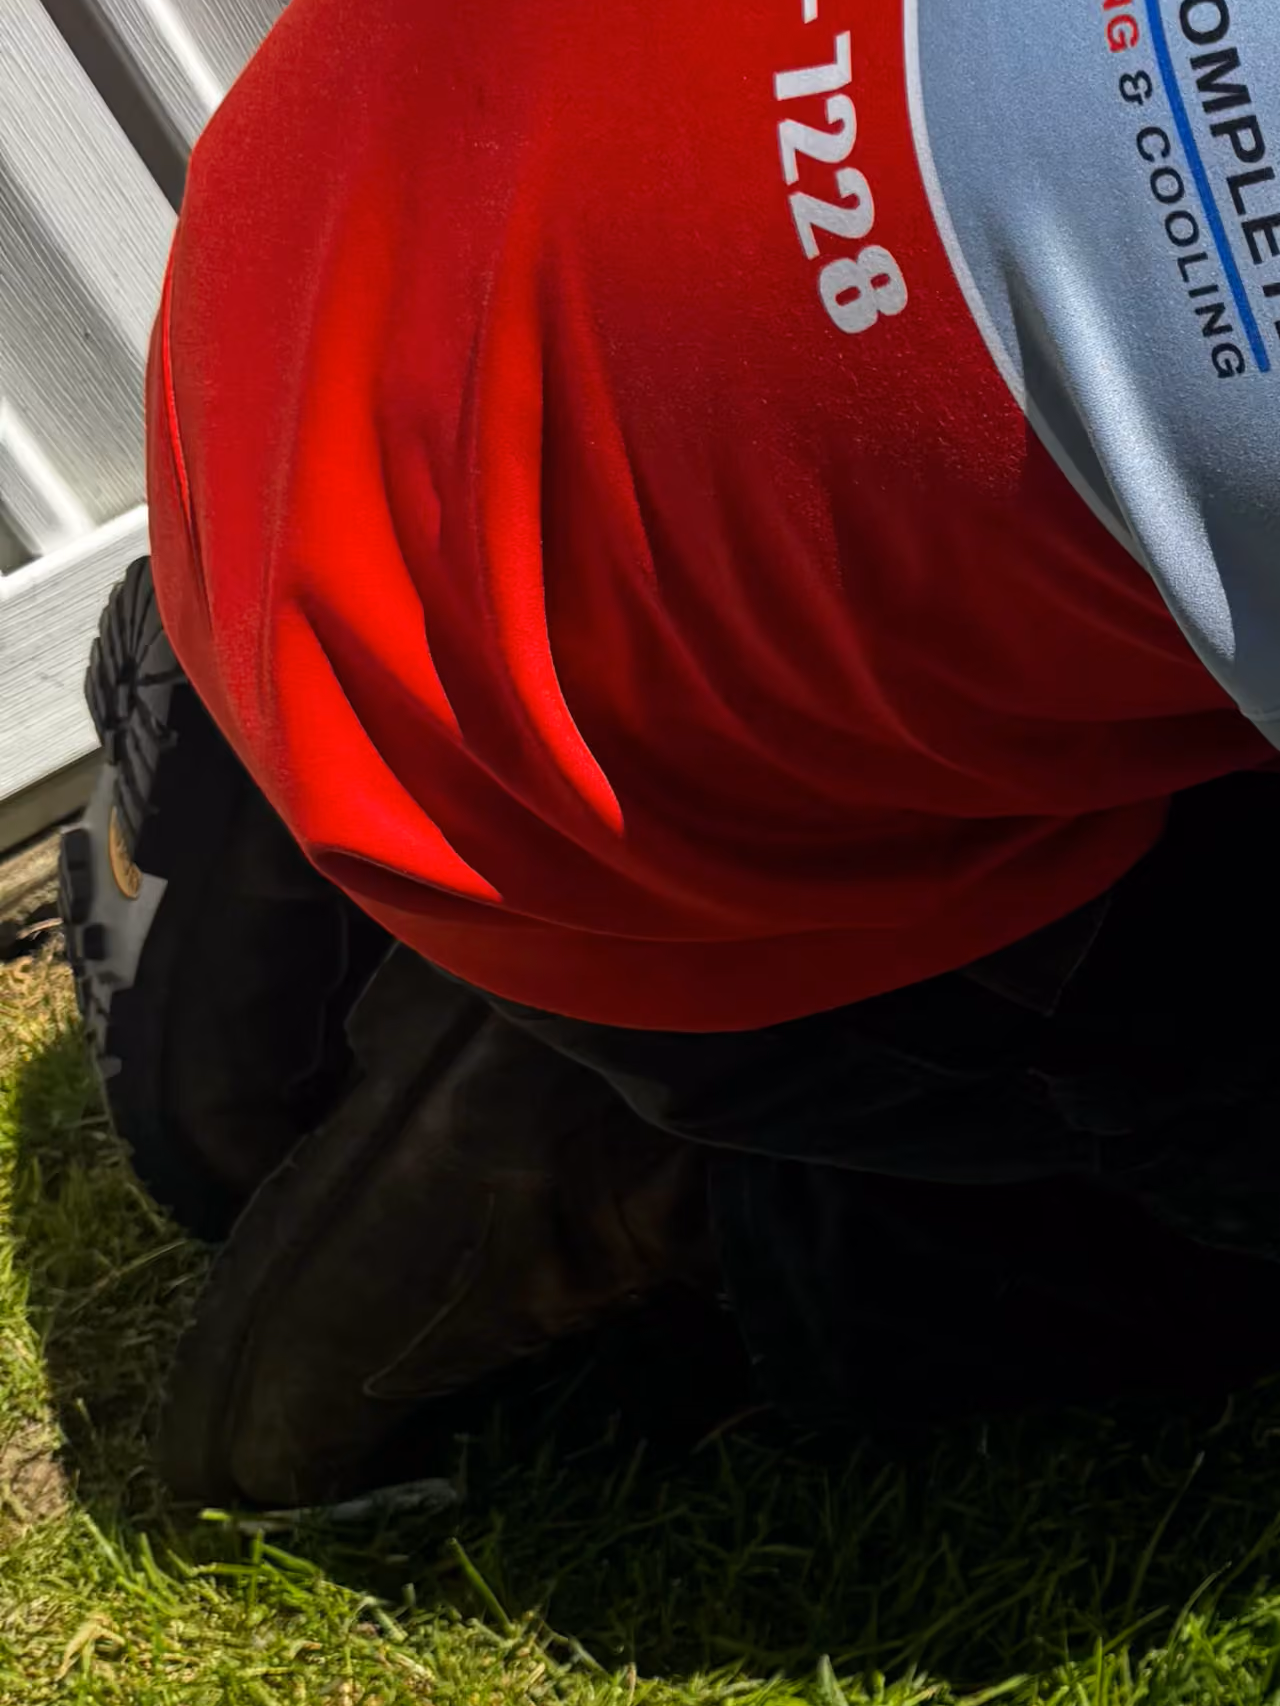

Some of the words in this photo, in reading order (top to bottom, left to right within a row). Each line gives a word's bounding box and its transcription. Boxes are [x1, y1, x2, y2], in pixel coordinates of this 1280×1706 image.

[773, 30, 909, 335] 7228
[1118, 69, 1153, 106] &
[1135, 125, 1246, 380] COOLING
